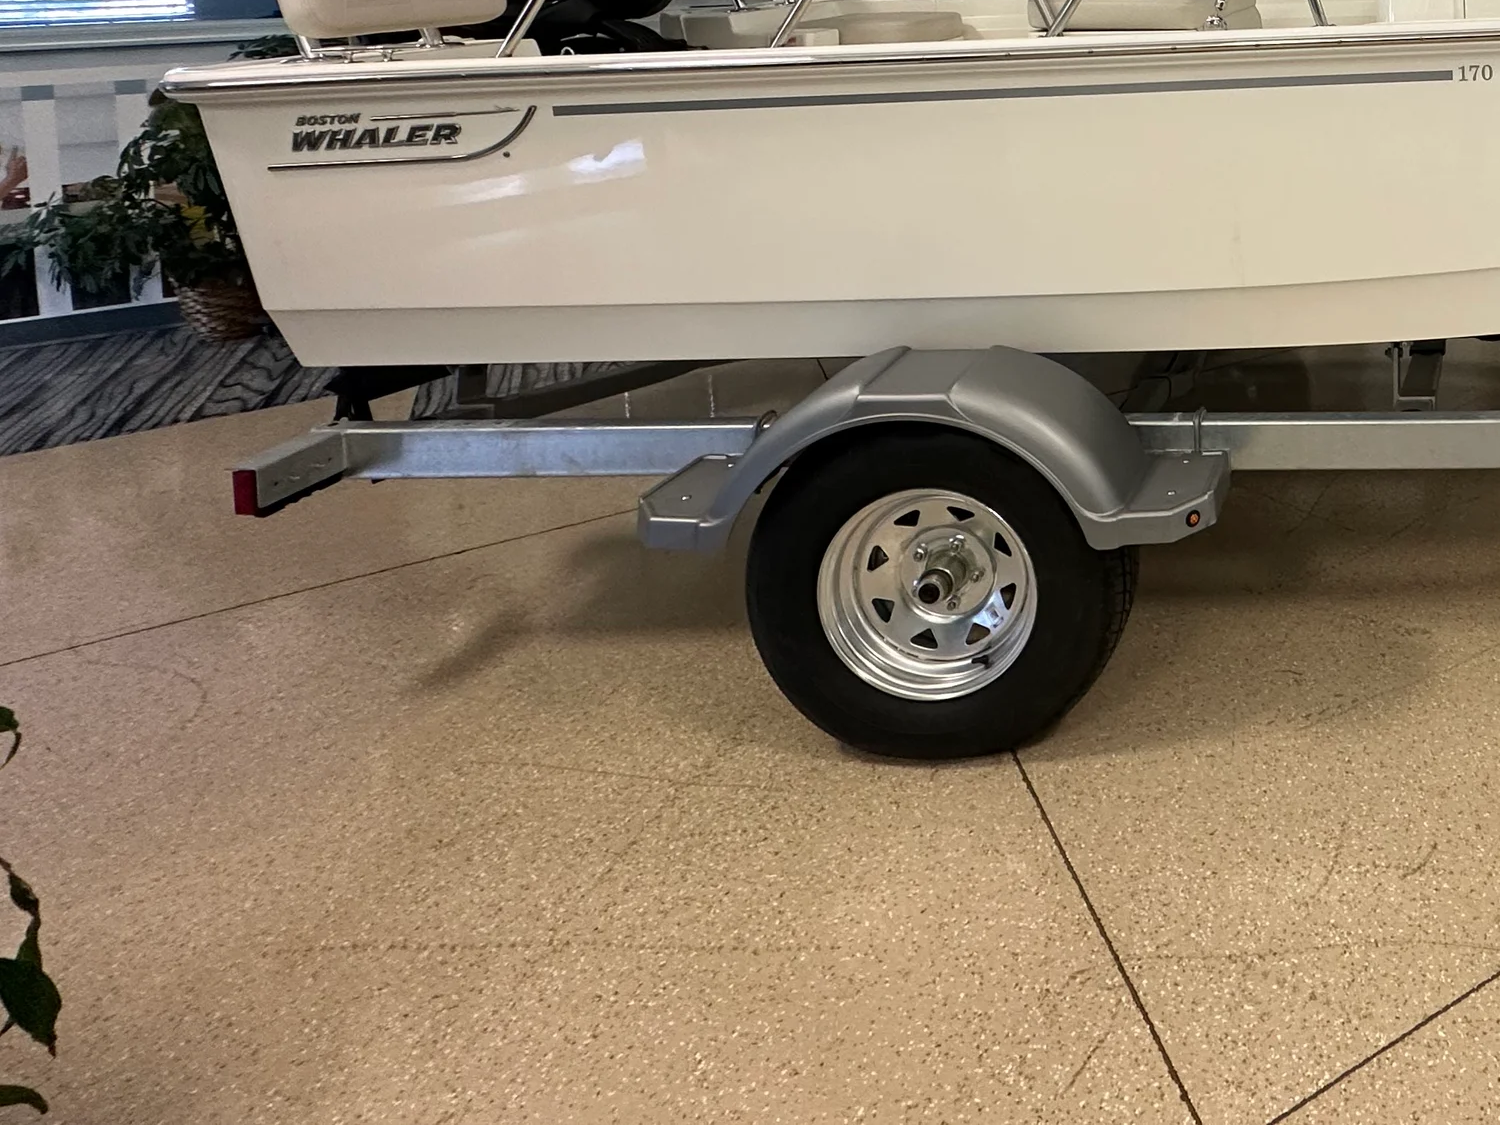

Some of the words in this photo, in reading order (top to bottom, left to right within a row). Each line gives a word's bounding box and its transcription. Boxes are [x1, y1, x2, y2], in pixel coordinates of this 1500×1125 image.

[1457, 64, 1494, 82] 170
[295, 113, 361, 127] BOSTON
[291, 122, 462, 152] WHALER
